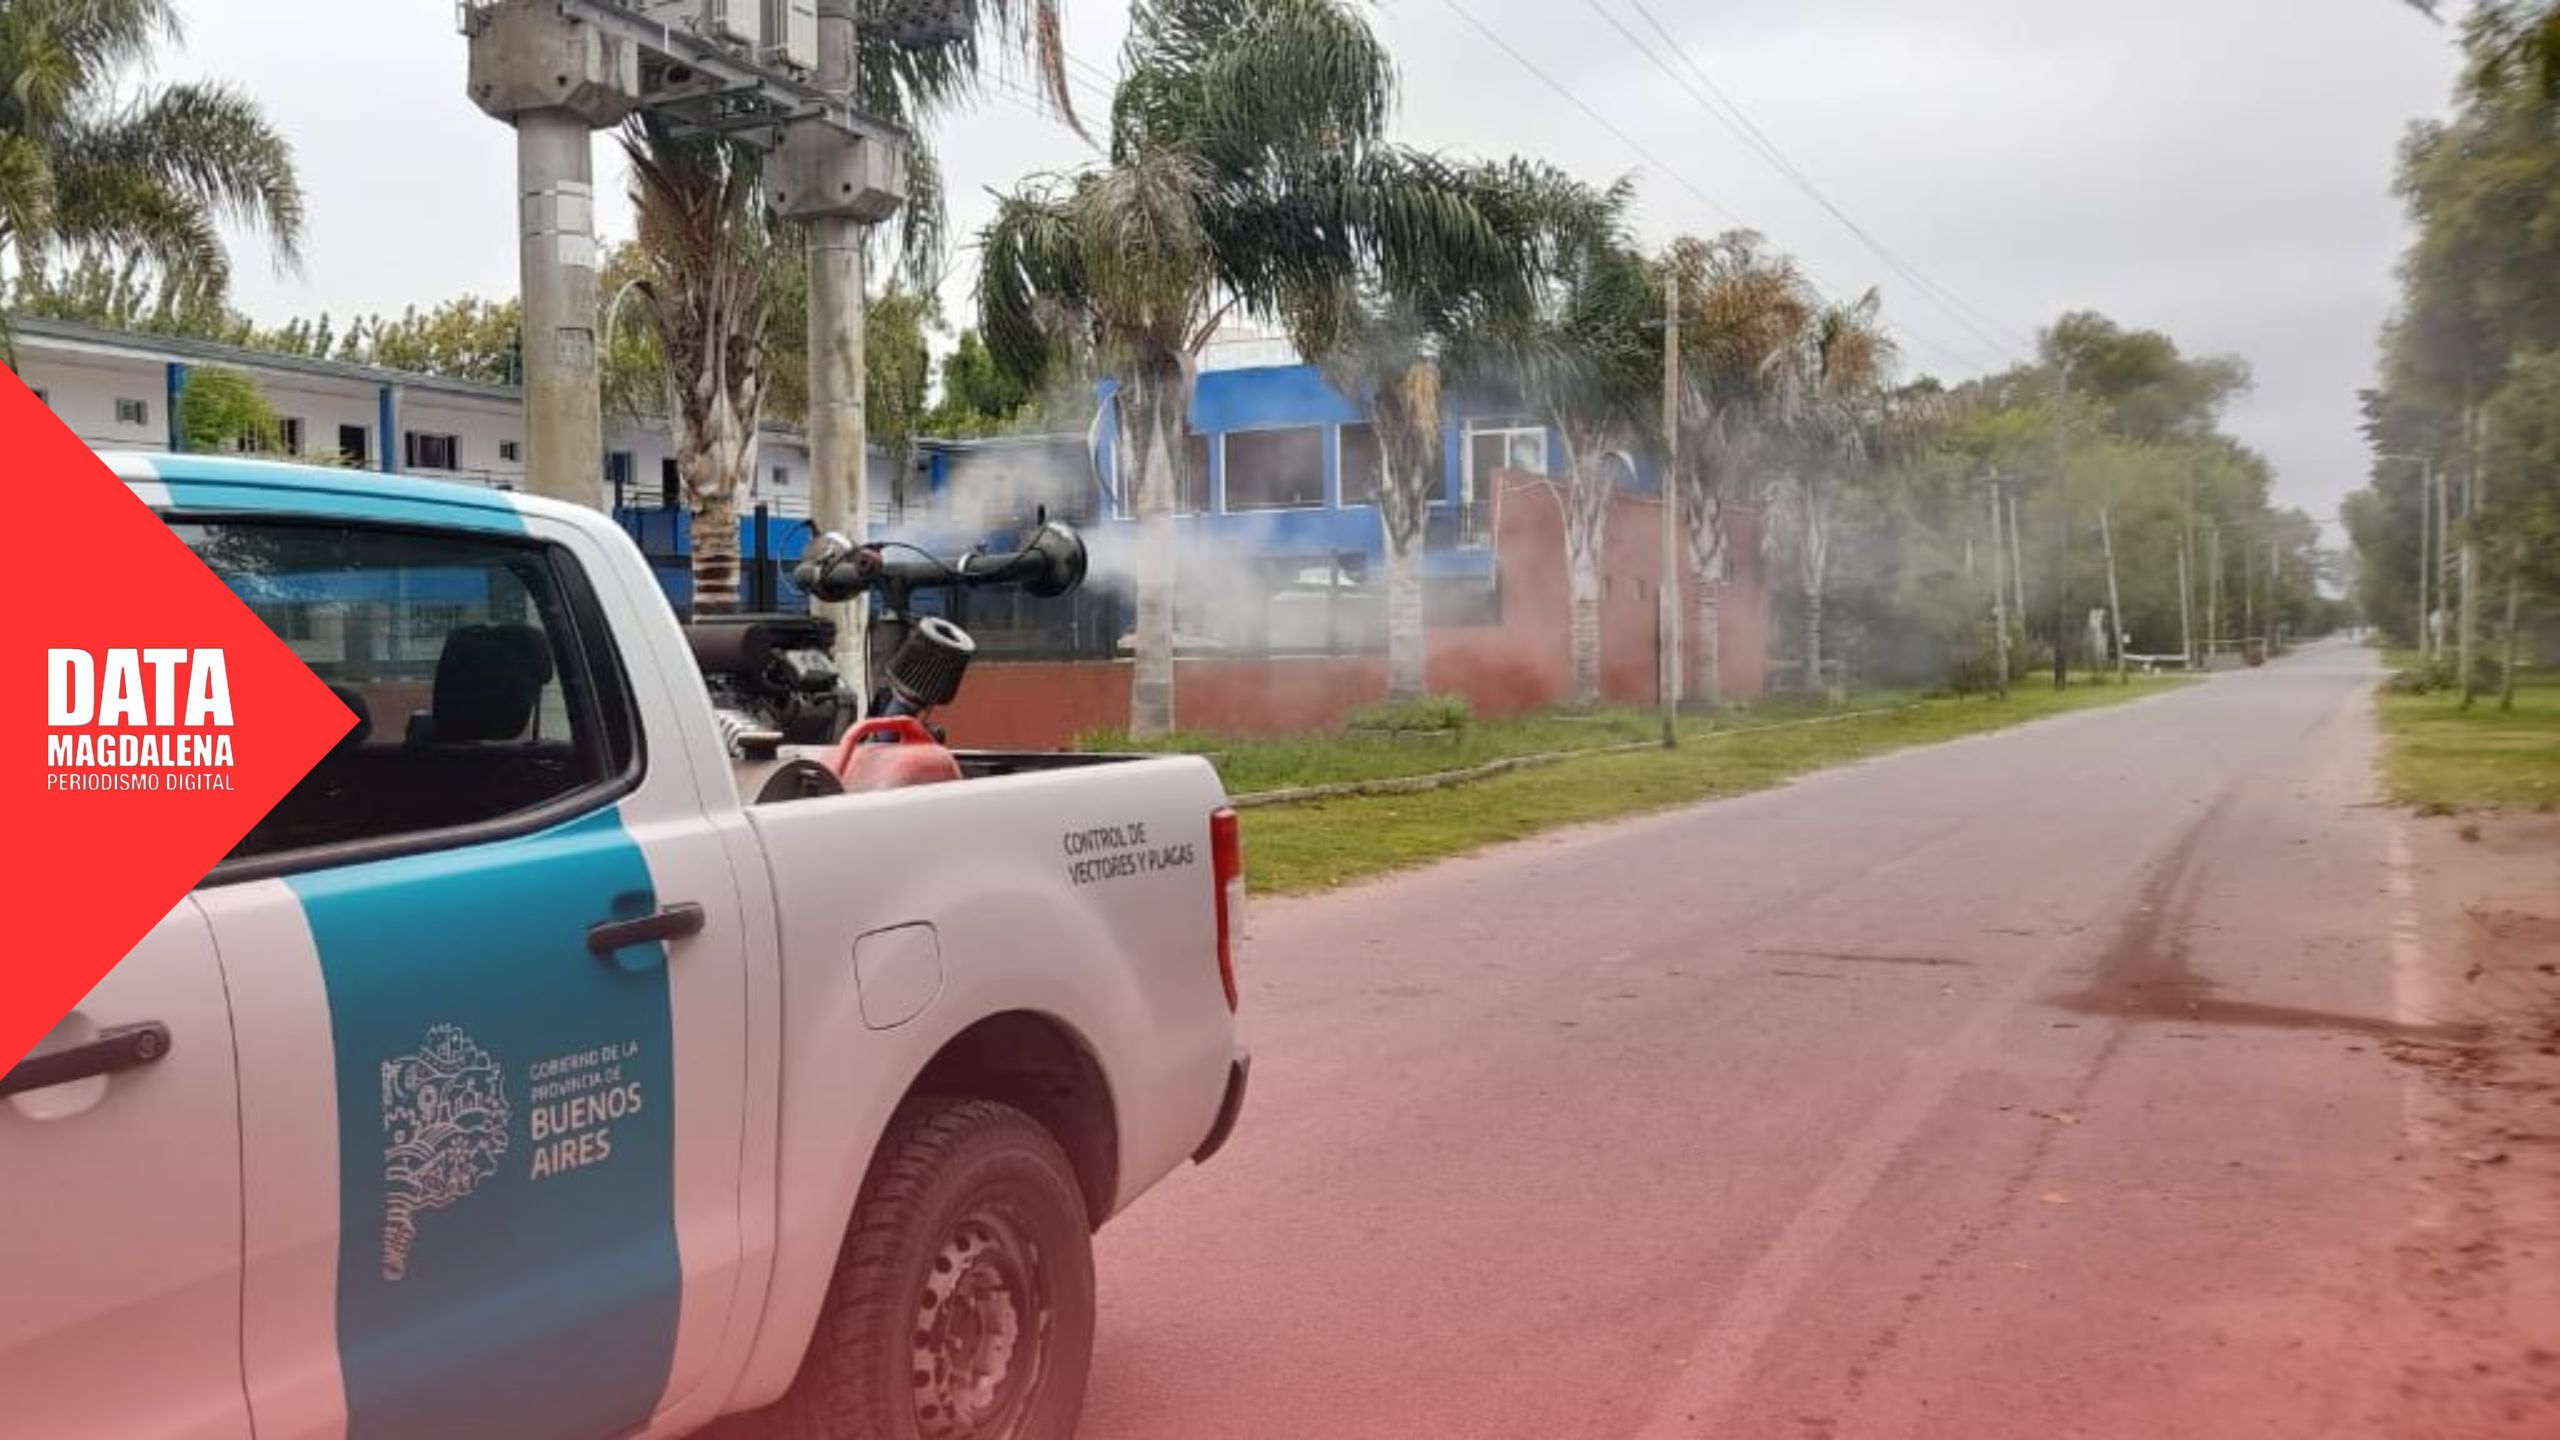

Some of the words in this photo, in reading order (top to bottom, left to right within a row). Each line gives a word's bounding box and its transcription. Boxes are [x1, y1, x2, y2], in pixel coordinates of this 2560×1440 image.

[1063, 826, 1127, 856] CONTROL
[1127, 822, 1147, 846] DE
[1067, 853, 1136, 886] VECTORES
[1137, 849, 1147, 871] Y
[1149, 843, 1195, 871] PLAGAS
[529, 1049, 599, 1080] GOBIERNO
[601, 1043, 619, 1063] DE
[621, 1040, 639, 1056] LA
[531, 1073, 602, 1102] PROVINCIA
[605, 1066, 621, 1083] DE
[530, 1082, 642, 1141] BUENOS
[530, 1129, 611, 1181] AIRES
